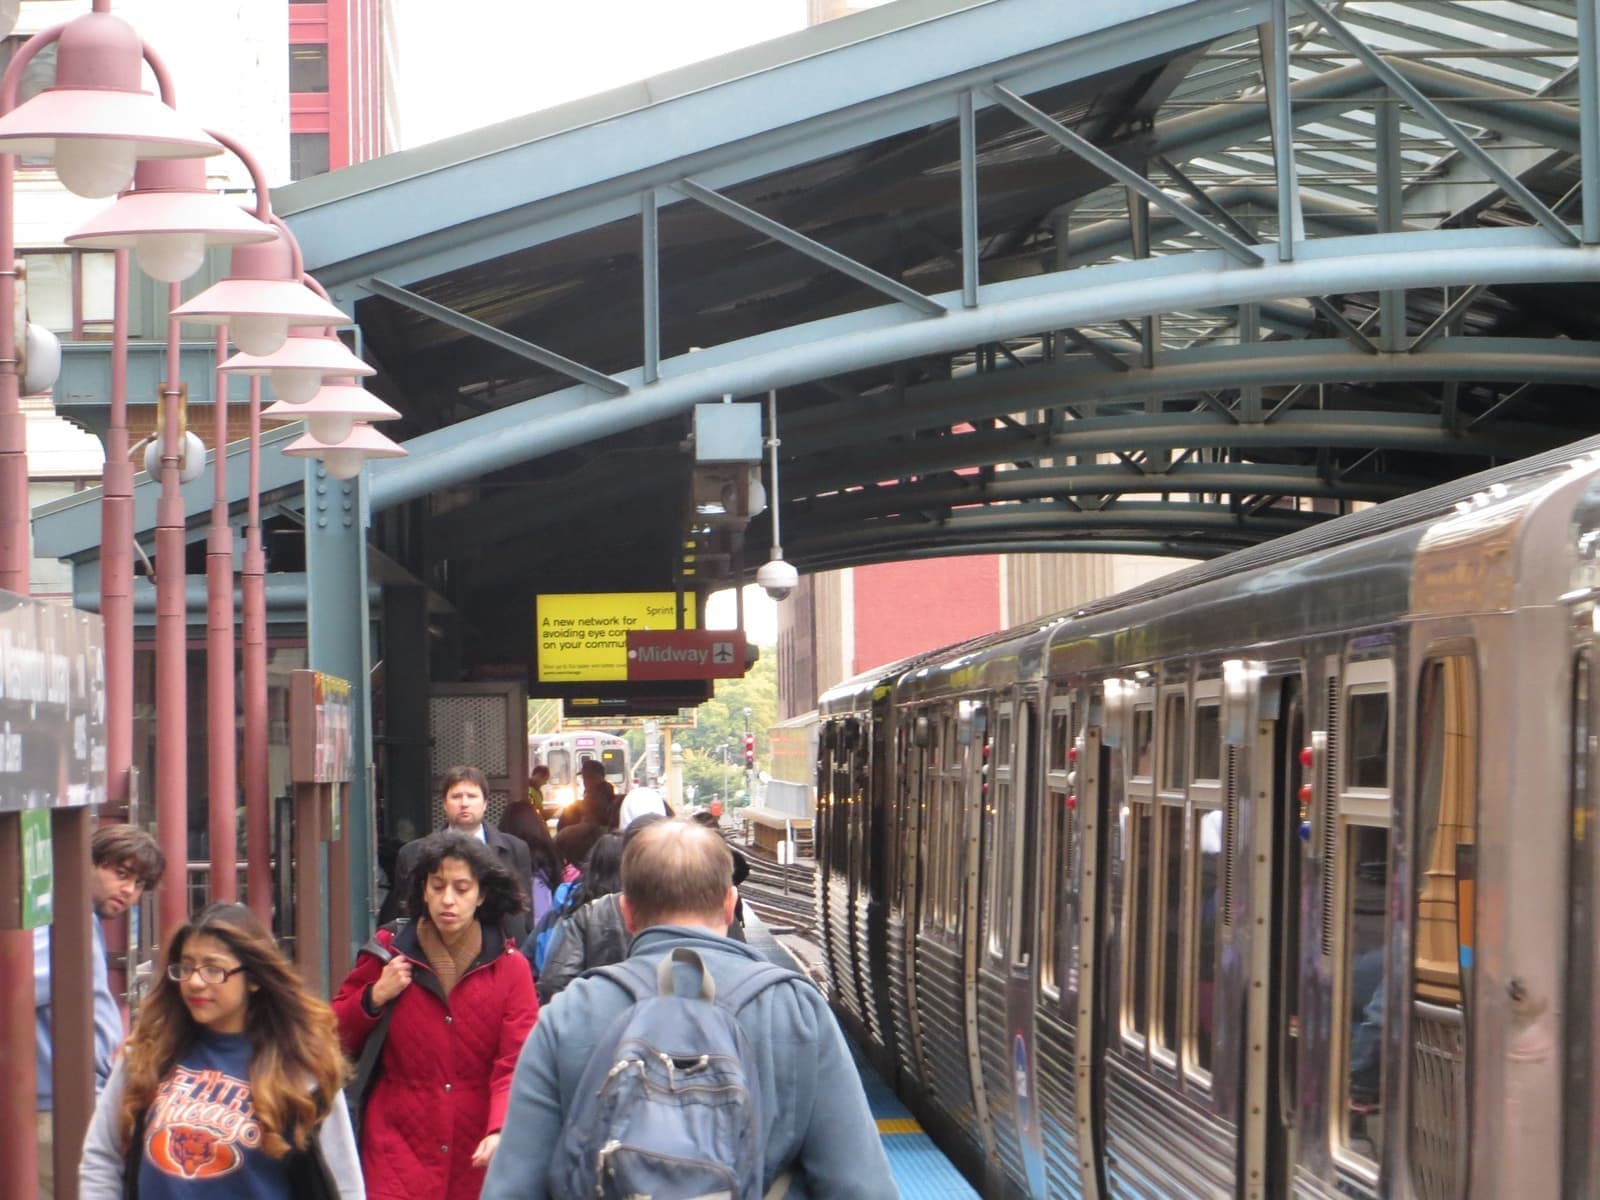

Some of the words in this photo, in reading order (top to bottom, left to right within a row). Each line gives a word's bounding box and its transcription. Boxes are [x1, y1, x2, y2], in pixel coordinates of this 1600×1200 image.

[646, 606, 674, 616] Sprint
[543, 617, 550, 626] A
[578, 617, 619, 626] network
[623, 616, 637, 626] for
[543, 629, 585, 639] avoiding
[587, 630, 605, 639] eye
[543, 642, 557, 650] on
[560, 641, 583, 651] your
[638, 646, 709, 664] Midway
